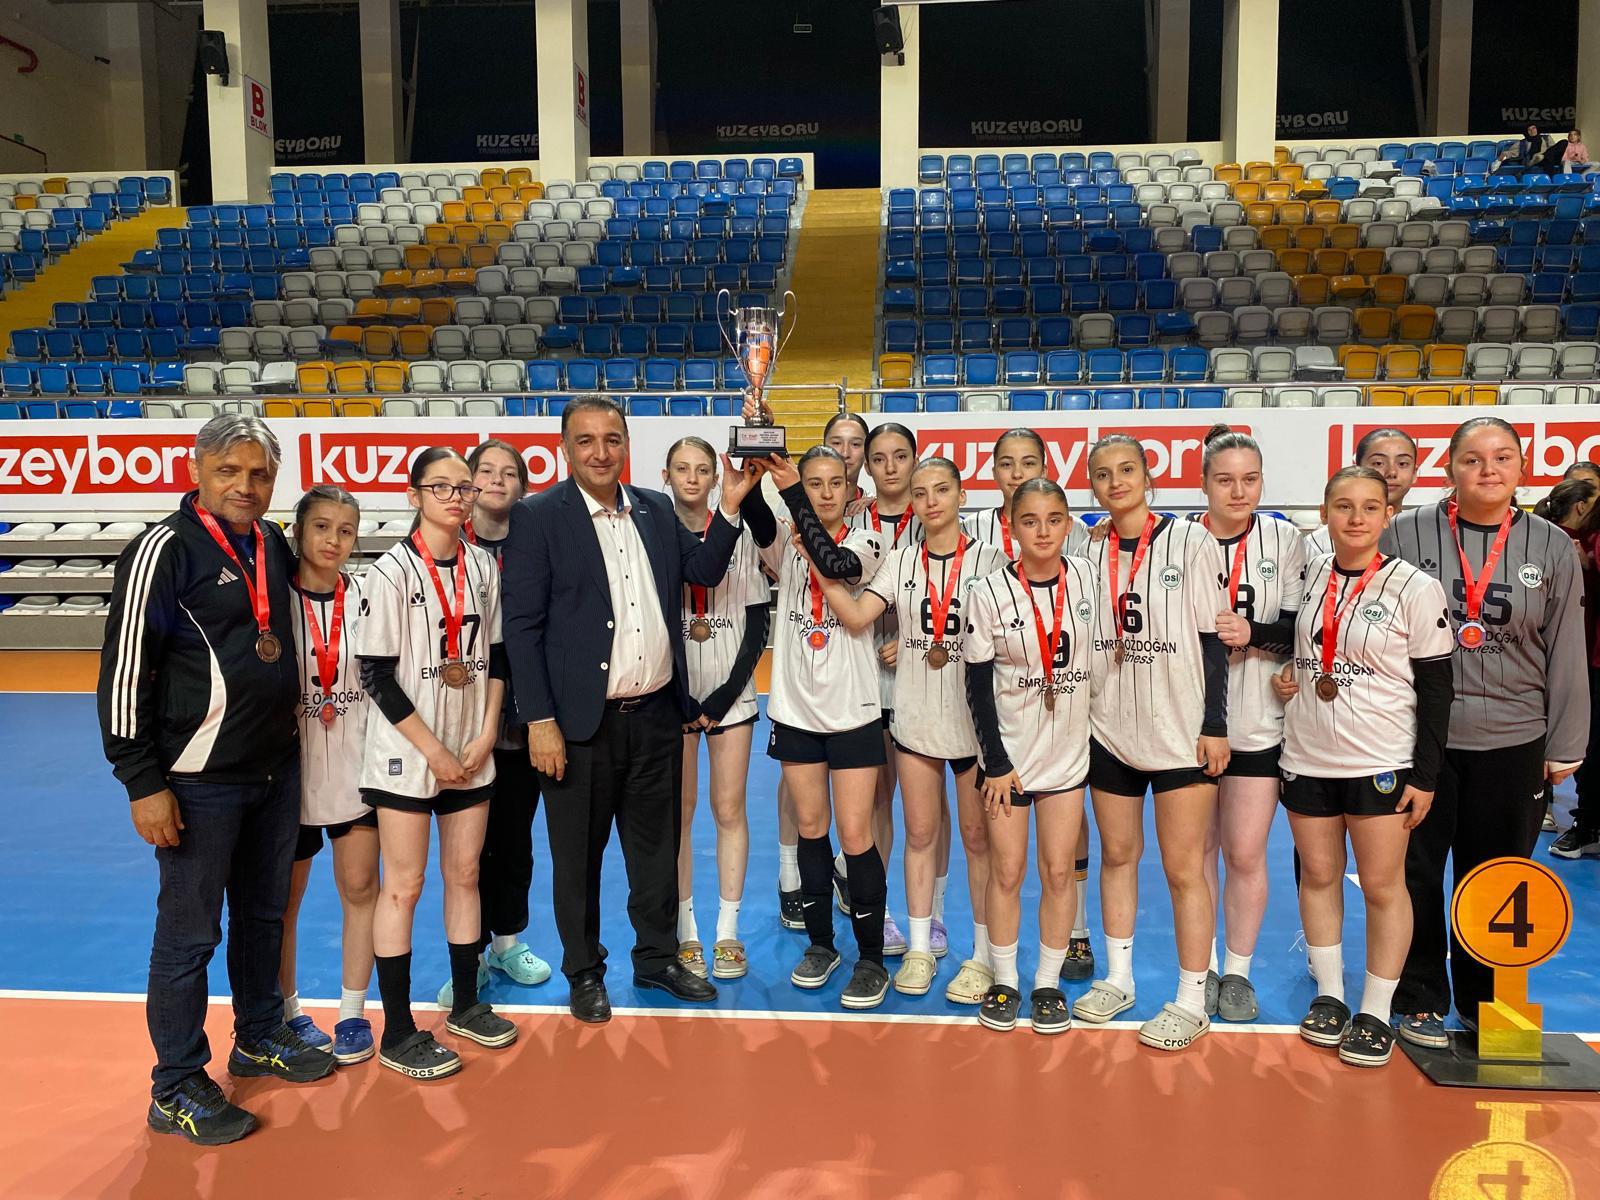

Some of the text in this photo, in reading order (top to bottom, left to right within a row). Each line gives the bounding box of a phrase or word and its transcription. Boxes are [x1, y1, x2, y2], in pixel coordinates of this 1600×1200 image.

[251, 82, 265, 118] B
[716, 122, 820, 138] KUZEYBORU
[971, 118, 1083, 135] KUZEYBORU
[0, 434, 197, 494] zeybor
[1124, 636, 1177, 654] ÖZDOĞAN
[1488, 881, 1534, 947] 4
[1163, 1036, 1192, 1047] crocs
[402, 1066, 434, 1077] crocs
